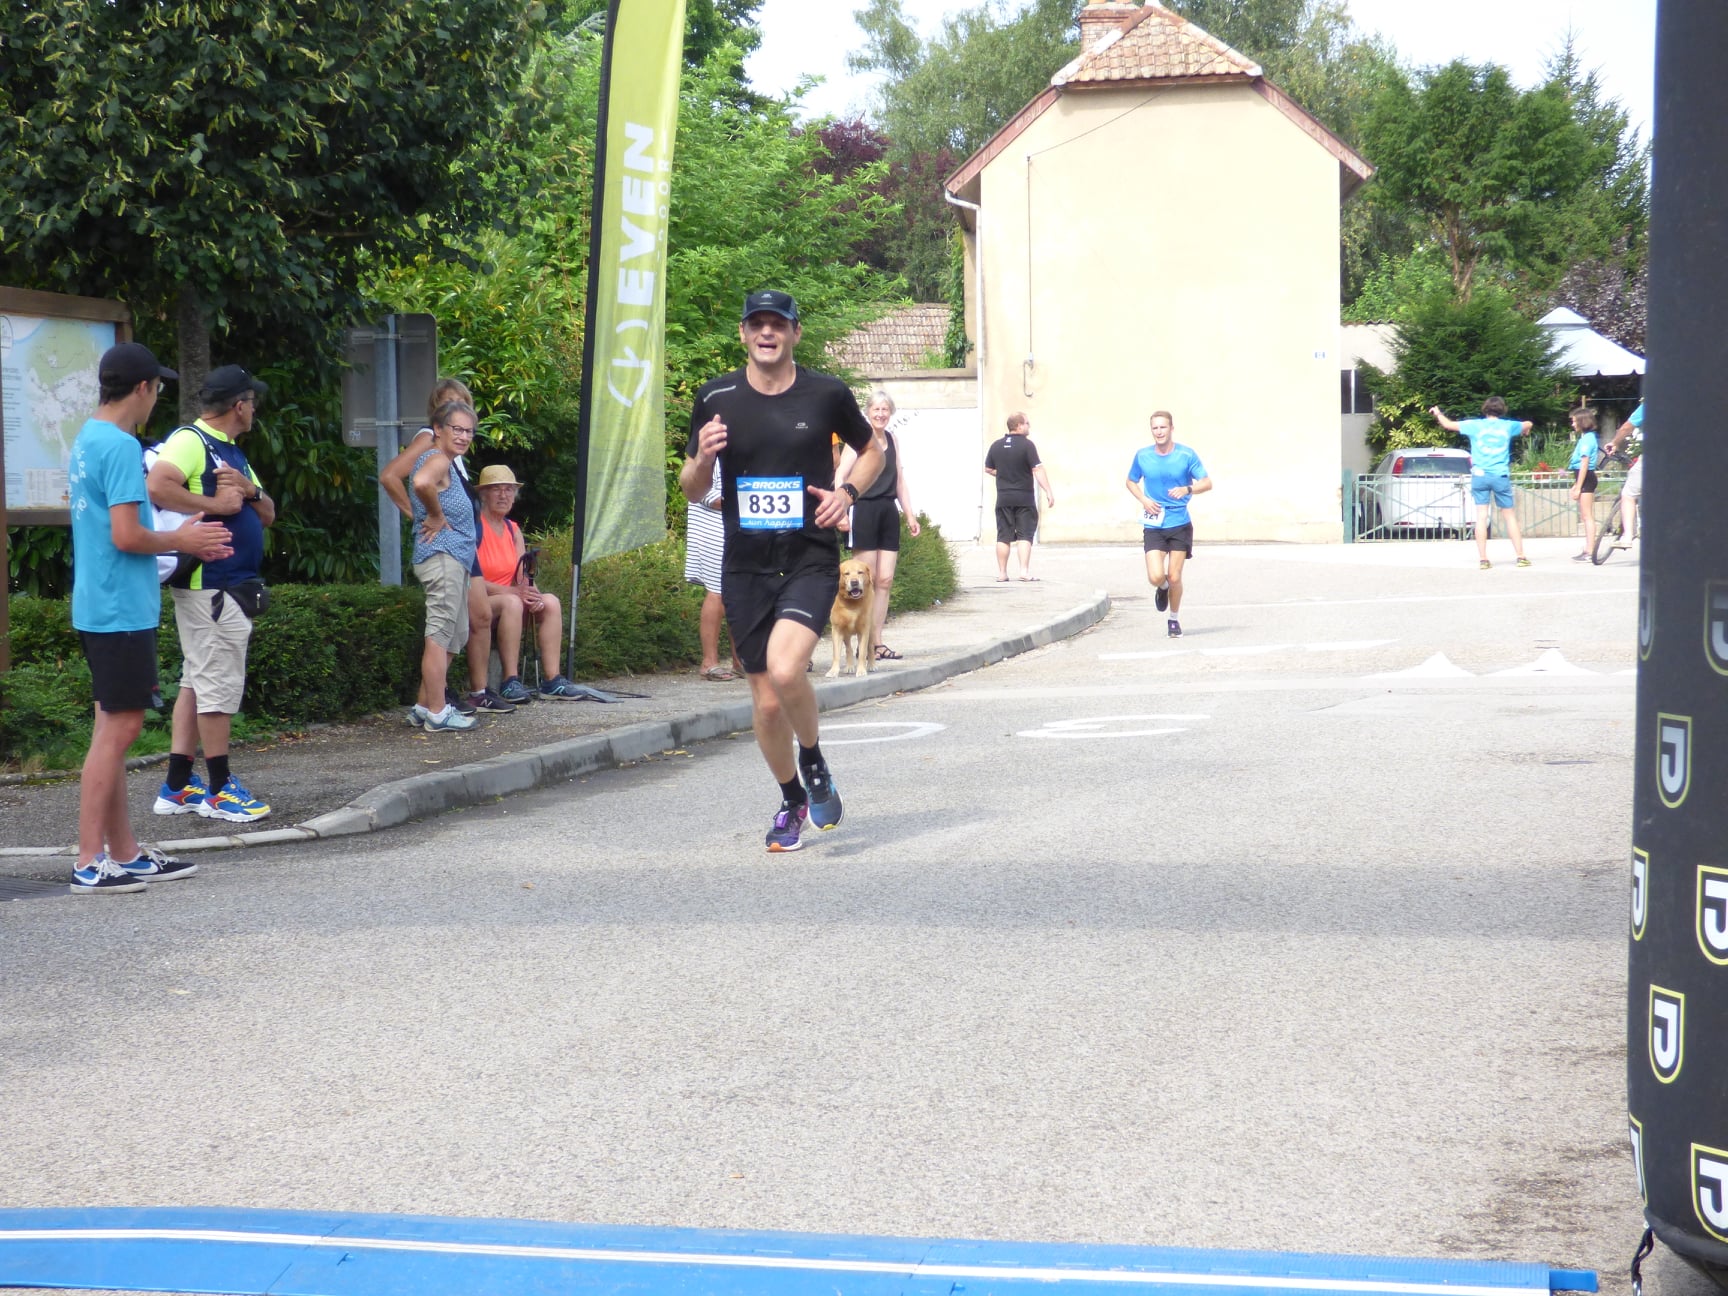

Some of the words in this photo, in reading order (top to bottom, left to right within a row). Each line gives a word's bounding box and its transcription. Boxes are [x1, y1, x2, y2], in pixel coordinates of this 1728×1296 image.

[752, 480, 800, 489] BROOKS
[749, 494, 791, 514] 833
[764, 518, 793, 528] happy
[1660, 726, 1685, 794] J
[1653, 998, 1678, 1069] J
